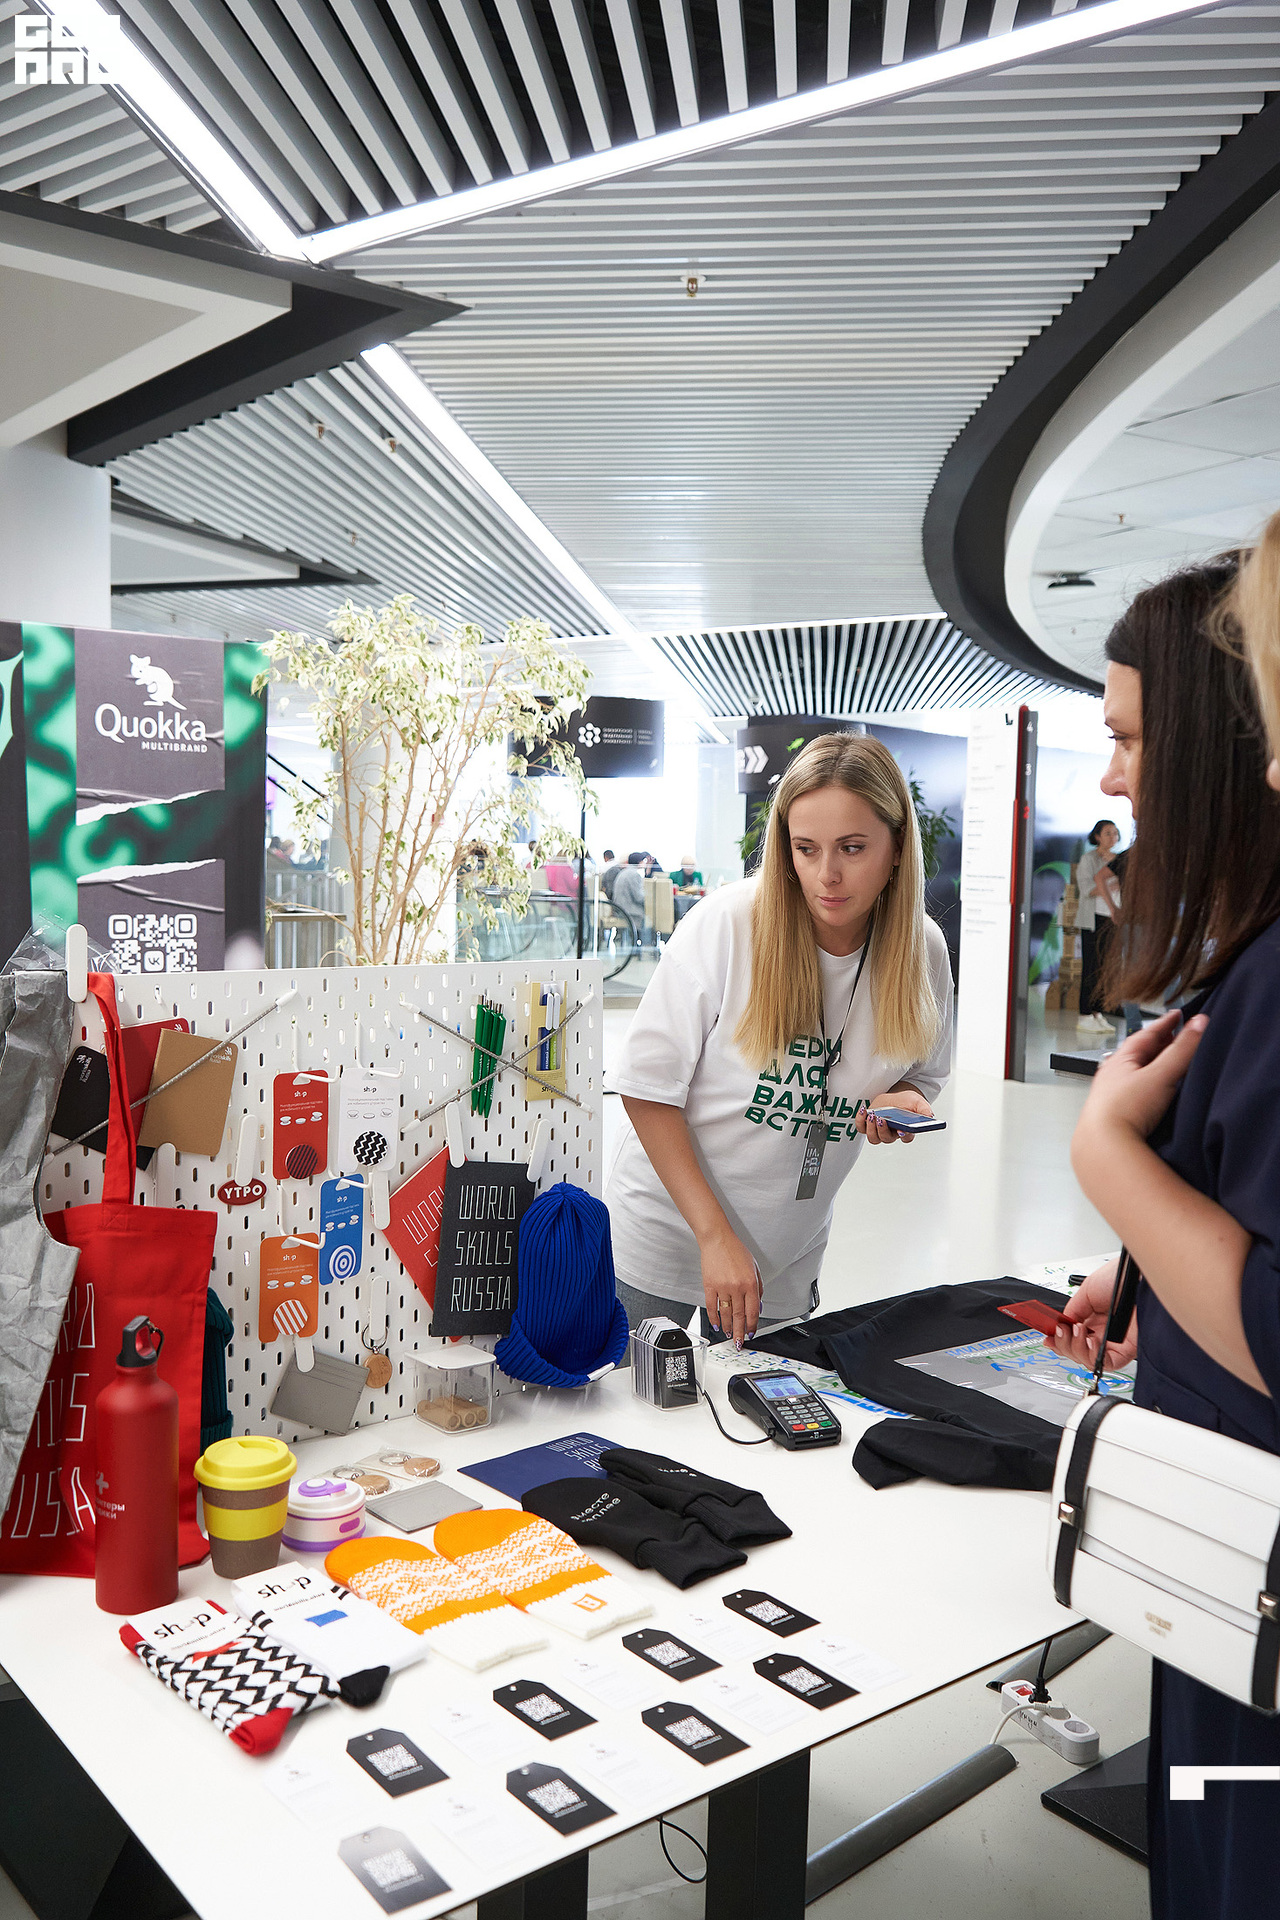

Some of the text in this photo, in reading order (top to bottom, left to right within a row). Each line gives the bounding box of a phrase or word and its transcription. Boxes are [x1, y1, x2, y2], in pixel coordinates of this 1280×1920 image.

[94, 703, 207, 743] Quokka
[1026, 721, 1033, 732] 4
[141, 741, 208, 753] MULTIBRAND
[1025, 763, 1032, 776] 3
[1023, 806, 1030, 819] 2
[784, 1034, 843, 1062] ЕРУ
[459, 1185, 516, 1220] WORLD
[402, 1185, 445, 1245] WOR
[455, 1231, 513, 1265] SKILLS
[451, 1276, 511, 1312] RUSSIA
[545, 1436, 594, 1453] WORLD
[564, 1442, 611, 1461] SKILLS
